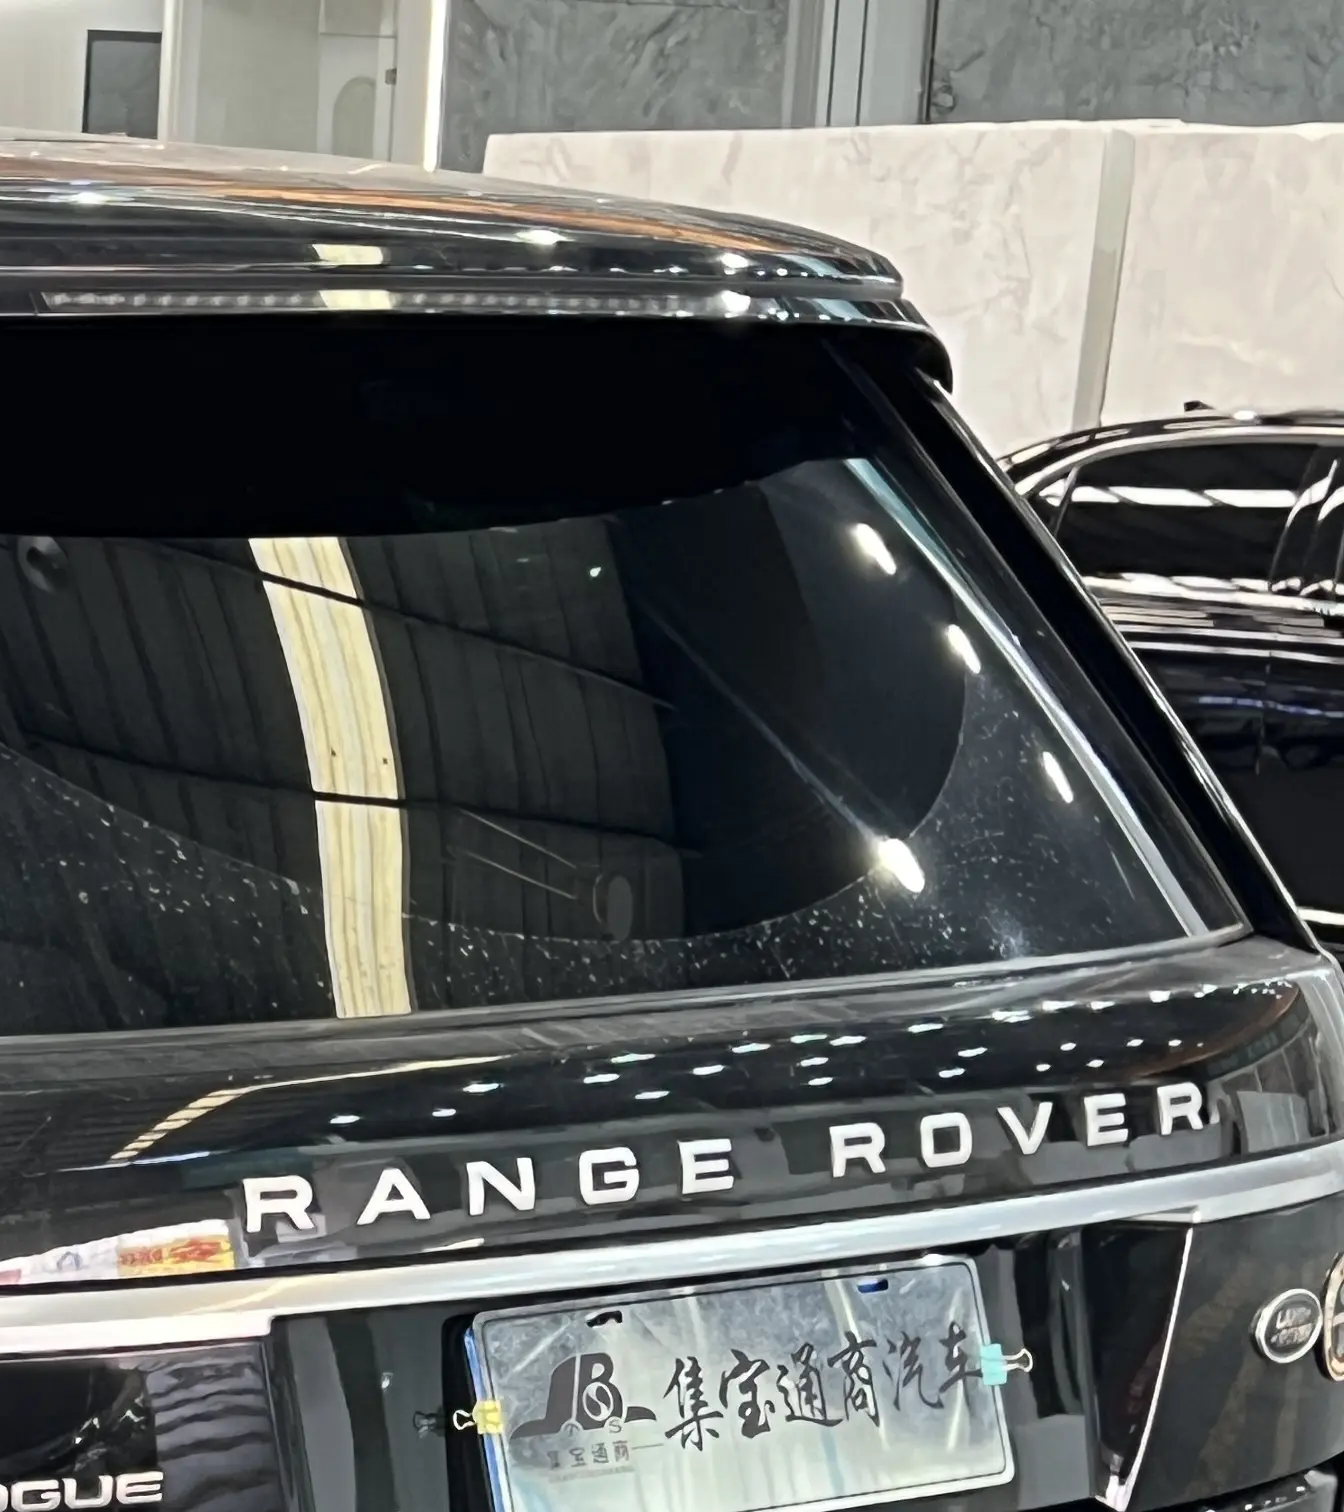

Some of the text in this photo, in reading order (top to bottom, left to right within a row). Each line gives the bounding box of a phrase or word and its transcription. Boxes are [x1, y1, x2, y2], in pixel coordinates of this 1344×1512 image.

[242, 1081, 1205, 1234] RANGE ROVER
[663, 1320, 984, 1452] 集宝通商汽车
